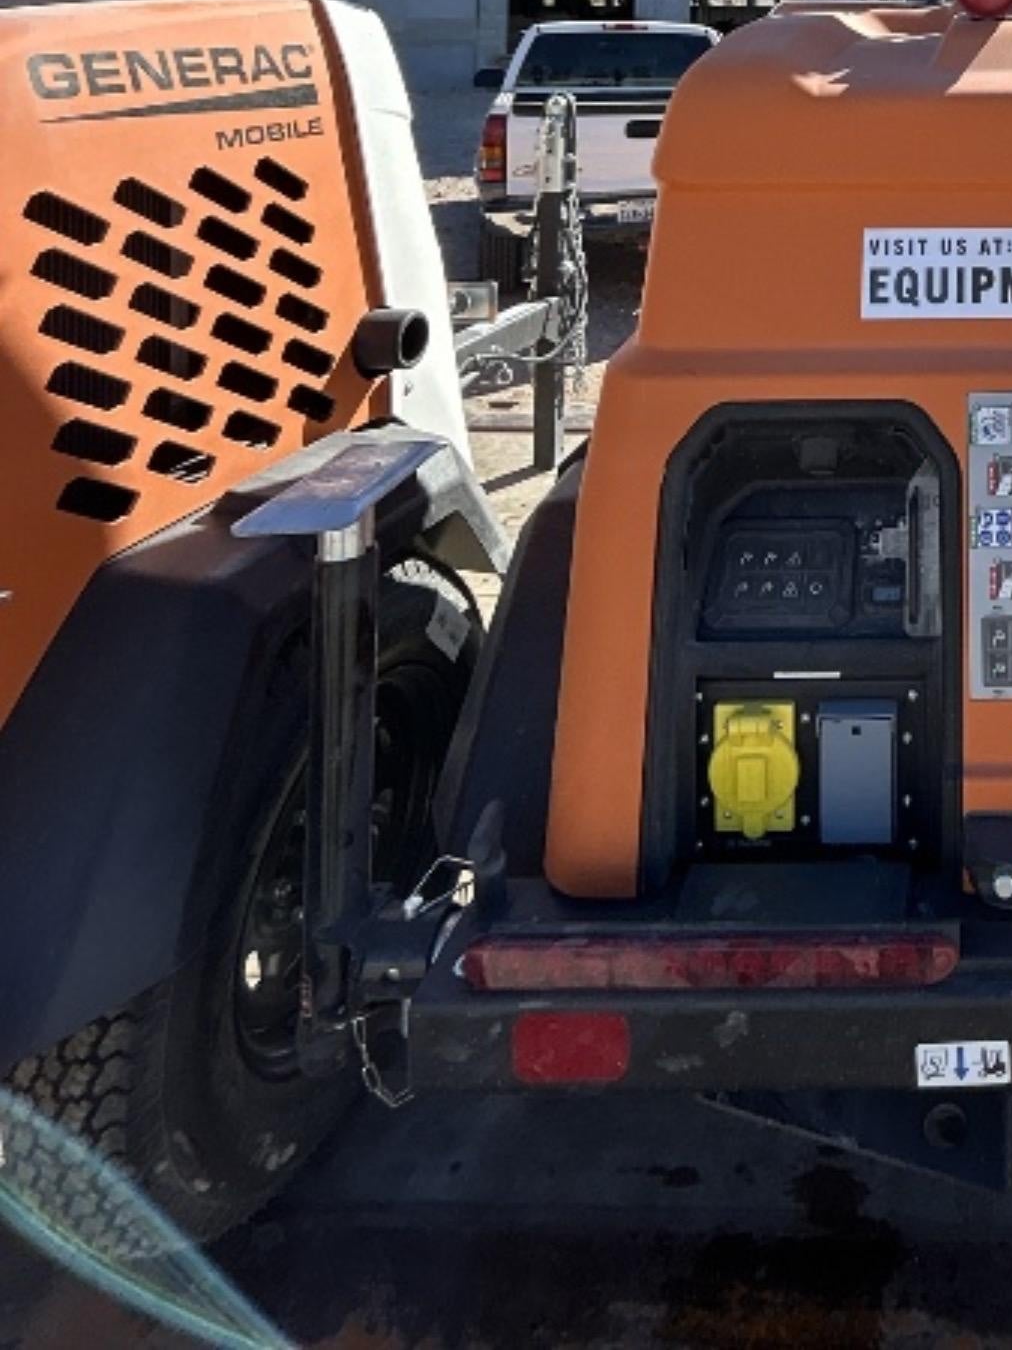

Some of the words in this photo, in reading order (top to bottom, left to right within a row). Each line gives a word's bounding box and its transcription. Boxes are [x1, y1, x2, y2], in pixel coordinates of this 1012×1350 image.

[26, 43, 314, 100] GENERAC
[215, 116, 325, 150] MOBILE
[868, 238, 928, 256] VISIT
[940, 238, 968, 256] US
